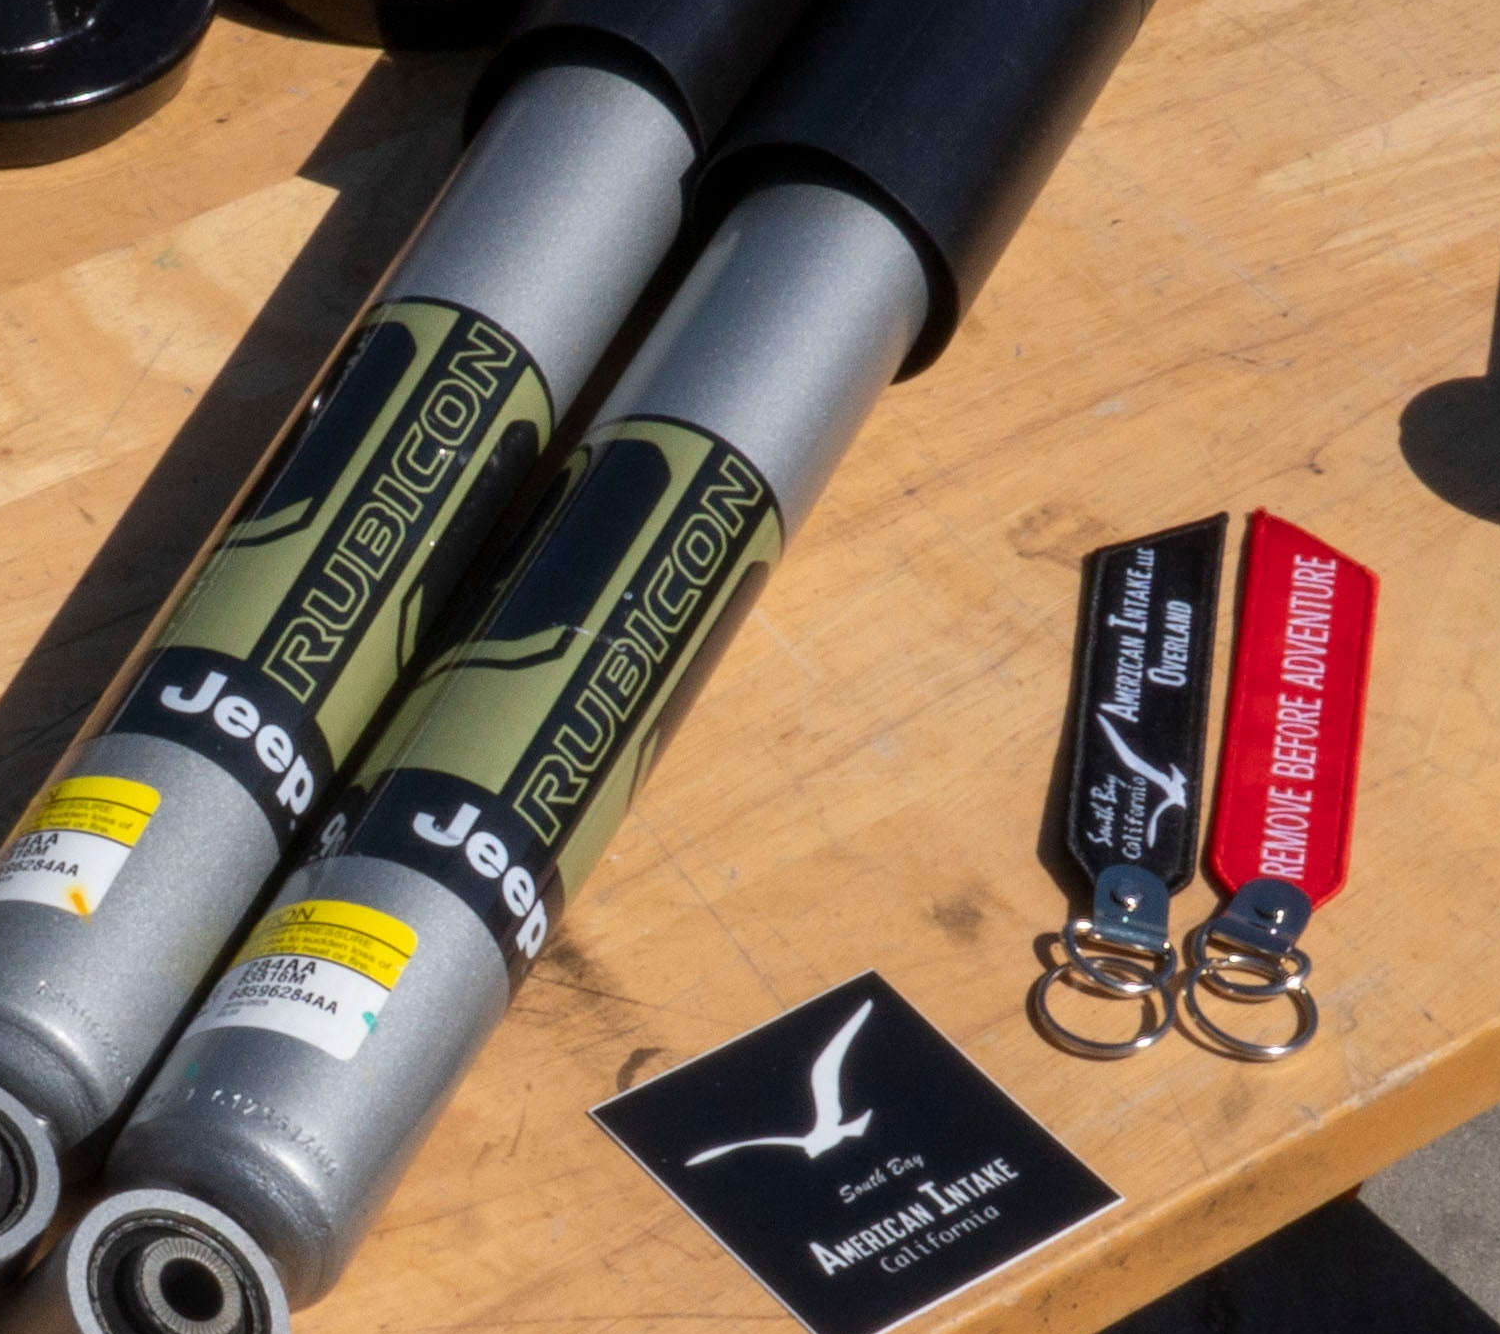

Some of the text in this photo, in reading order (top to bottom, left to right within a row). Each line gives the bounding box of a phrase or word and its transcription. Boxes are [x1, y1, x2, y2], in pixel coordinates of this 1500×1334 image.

[264, 319, 519, 704] RUBICON
[513, 453, 767, 848] RUBICON
[1099, 635, 1147, 723] AMERICAN
[1148, 600, 1193, 687] OVERLAND
[160, 670, 314, 818] Jeep
[1258, 554, 1338, 880] REMOVE BEFORE ADVENTURE
[412, 801, 549, 961] Jeep
[809, 1157, 1020, 1276] AMERICAN INTAKE
[838, 1153, 925, 1204] South Bay
[879, 1204, 1001, 1273] California
